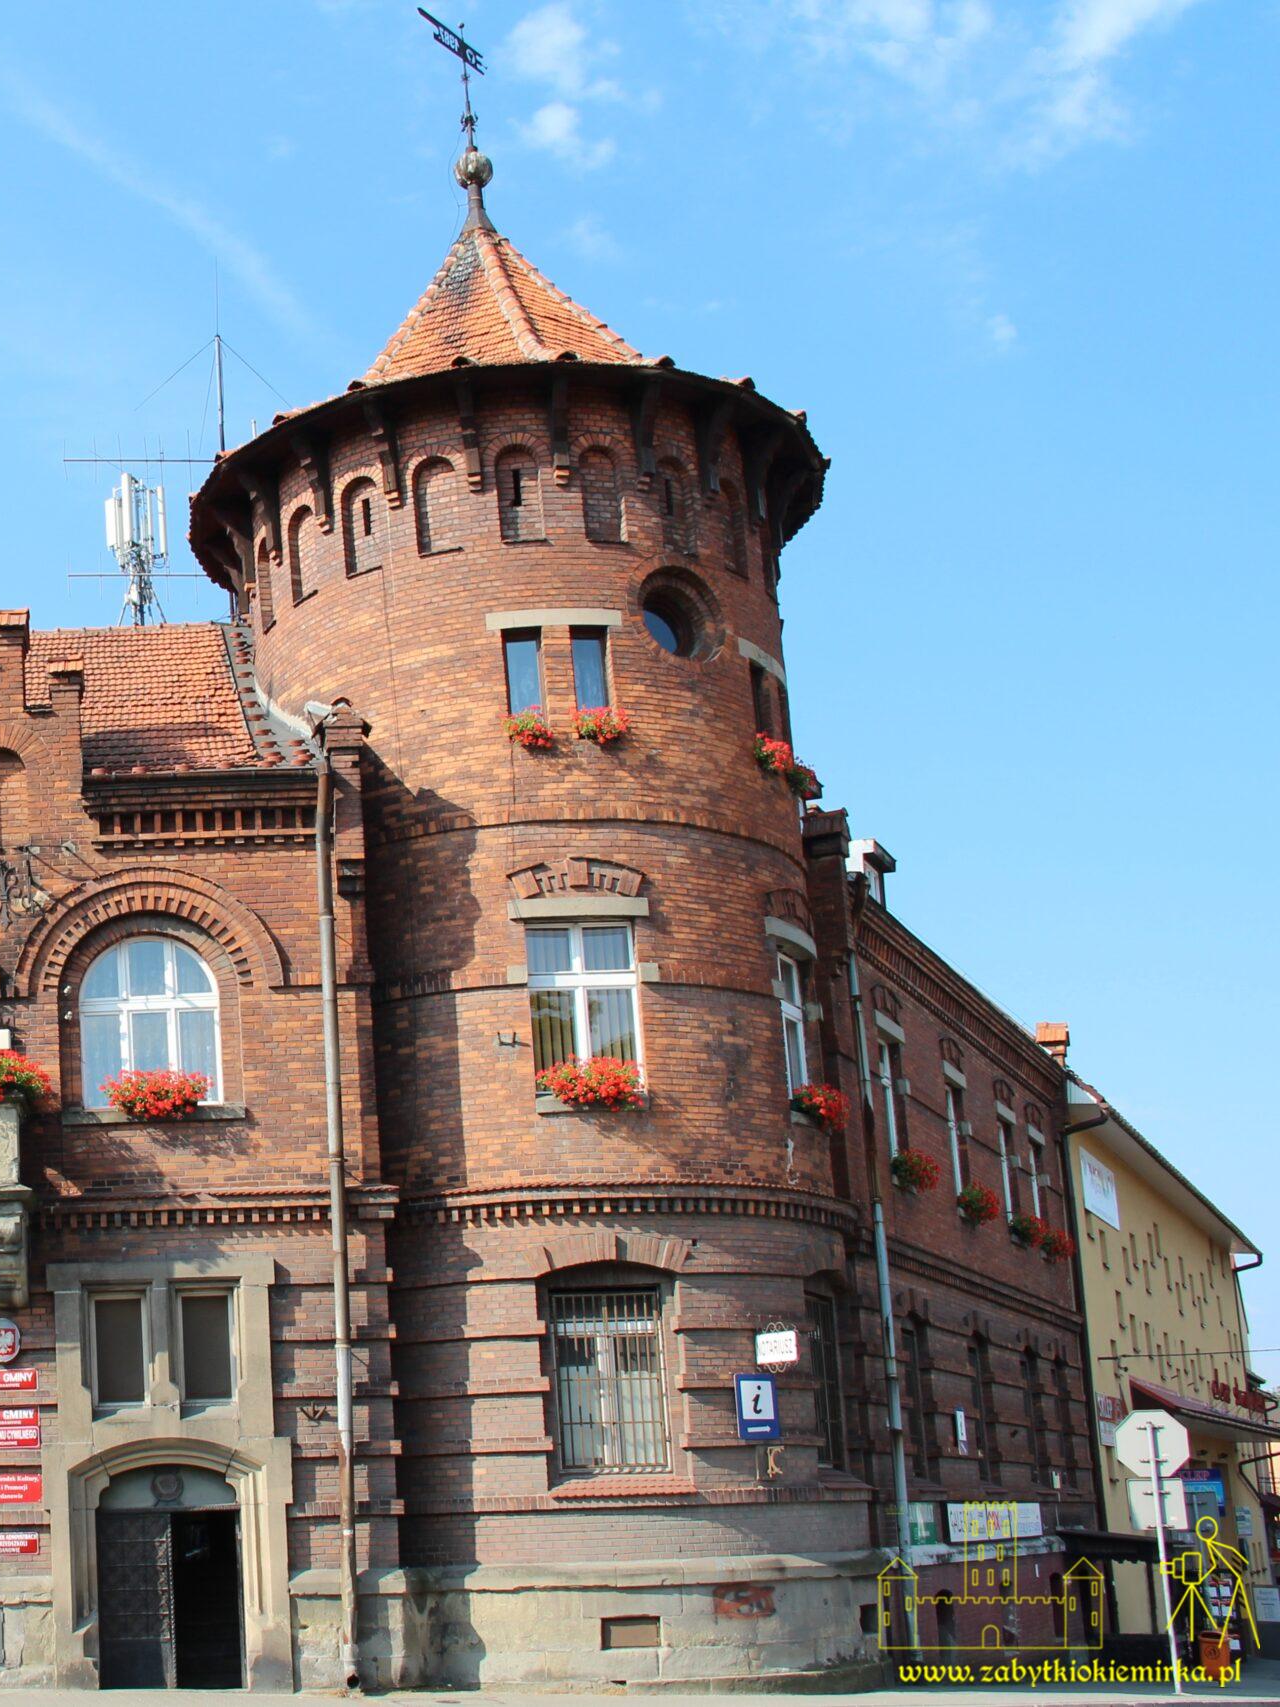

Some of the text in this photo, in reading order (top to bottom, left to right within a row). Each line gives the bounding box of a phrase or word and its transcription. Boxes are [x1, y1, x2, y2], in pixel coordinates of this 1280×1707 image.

[3, 1372, 33, 1382] GMINY
[3, 1409, 34, 1419] GMINY
[7, 1429, 37, 1439] CYWILNEGO
